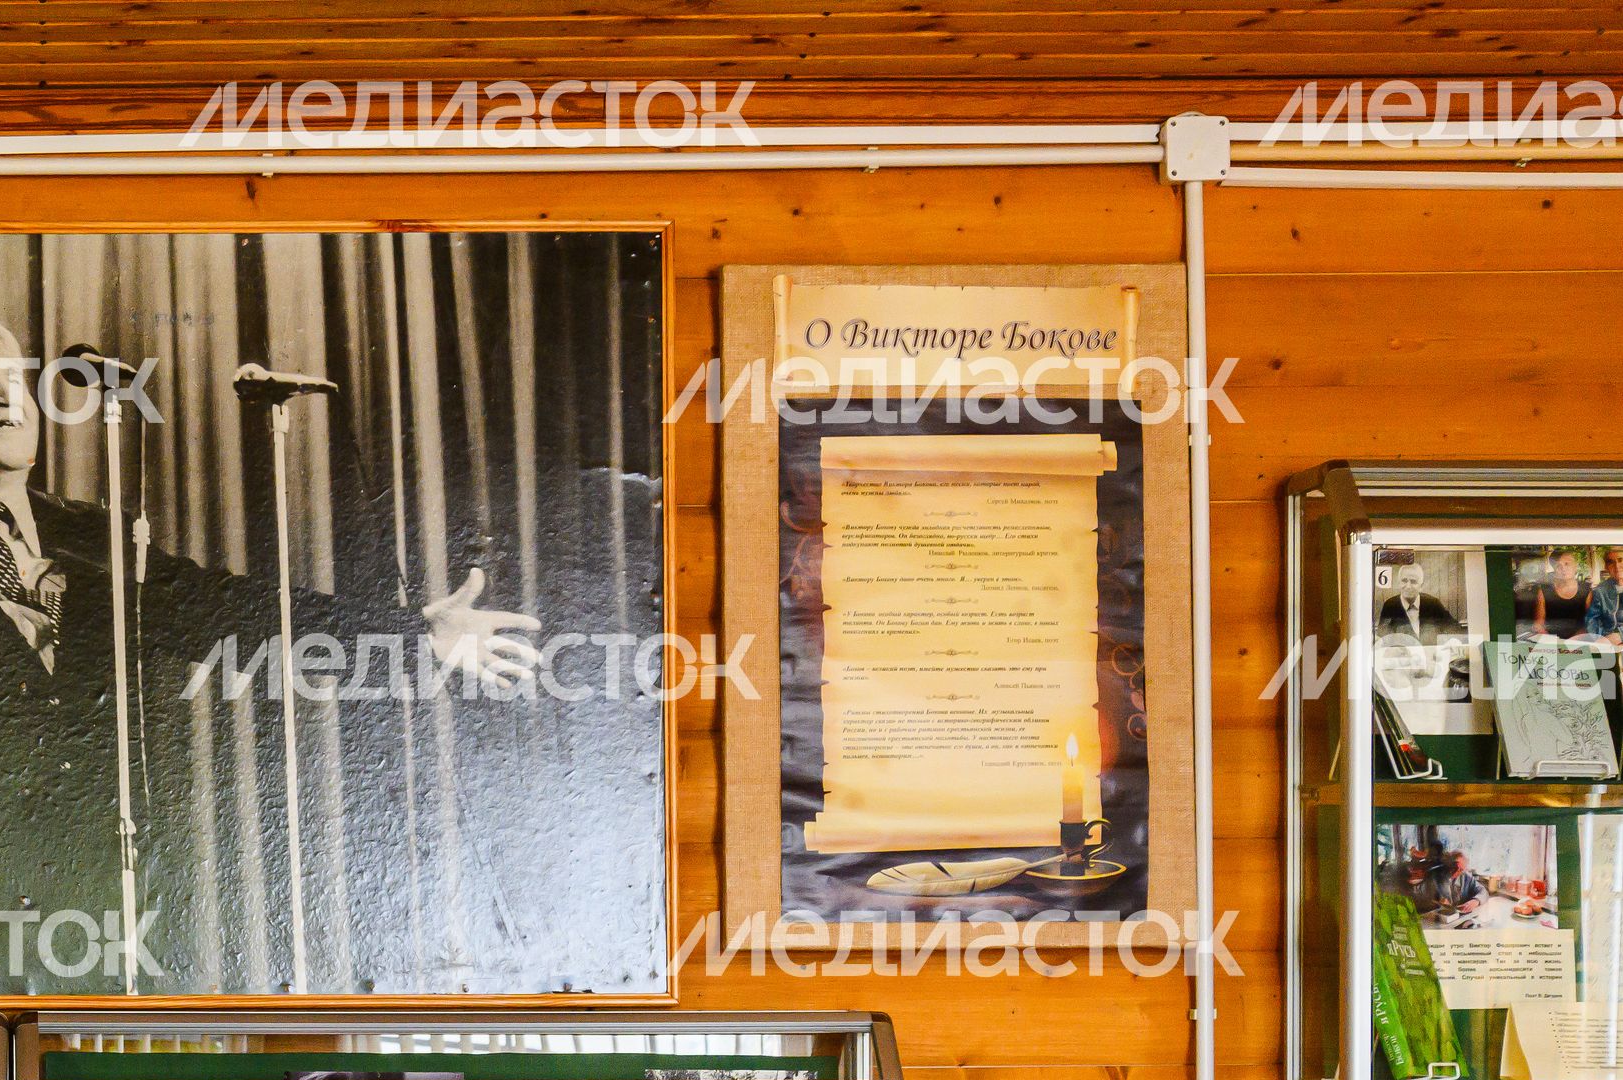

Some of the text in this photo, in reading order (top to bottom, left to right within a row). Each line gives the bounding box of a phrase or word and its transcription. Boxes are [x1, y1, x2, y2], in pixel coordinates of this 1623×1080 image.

[804, 318, 1117, 359] О Викторе Бокове
[1378, 570, 1388, 585] 6
